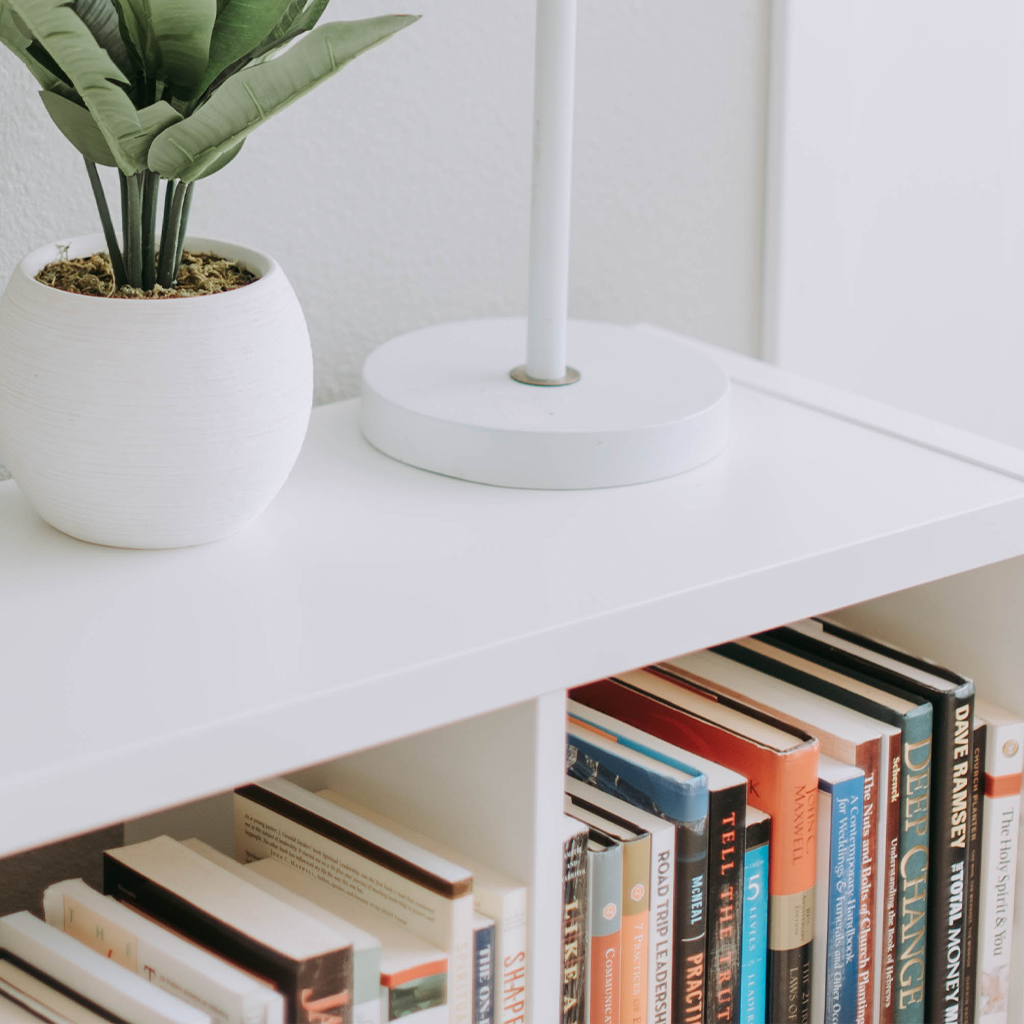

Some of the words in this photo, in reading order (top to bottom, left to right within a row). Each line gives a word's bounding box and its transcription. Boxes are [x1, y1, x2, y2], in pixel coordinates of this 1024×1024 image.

[953, 704, 970, 760] DAVE
[863, 771, 874, 801] The
[891, 756, 901, 803] Schenck
[905, 733, 932, 836] DEEP
[972, 747, 980, 792] CHURCH
[836, 797, 849, 815] for
[850, 795, 859, 804] A
[950, 762, 968, 848] RAMSEY
[970, 793, 978, 841] PLANTER
[793, 784, 806, 866] MAXWELL
[863, 802, 873, 837] Nuts
[1000, 807, 1014, 837] The
[721, 811, 736, 876] TELL
[835, 817, 848, 878] Weddings
[845, 807, 859, 896] Contemporary
[862, 839, 872, 865] and
[998, 839, 1012, 870] Holy
[657, 850, 670, 898] ROAD
[860, 865, 872, 901] Bolts
[887, 838, 898, 909] Understanding
[951, 860, 964, 873] THE
[690, 874, 704, 925] McNEAL
[747, 874, 760, 901] 5
[836, 880, 846, 893] &
[948, 870, 964, 926] TOTAL
[994, 873, 1011, 912] Spirit
[634, 922, 643, 930] 7
[656, 899, 669, 937] TRIP
[719, 886, 734, 940] THE
[749, 907, 757, 951] LEVELS
[835, 896, 845, 947] Funerals
[859, 906, 870, 915] of
[887, 909, 896, 926] the
[899, 845, 929, 1010] CHANGE
[994, 917, 1005, 930] &
[564, 899, 578, 984] LIKE
[845, 898, 856, 964] Handbook
[859, 918, 870, 968] Church
[887, 927, 895, 953] Book
[993, 931, 1006, 957] You
[479, 944, 491, 983] THE
[632, 934, 644, 995] PRACTICES
[834, 950, 843, 969] and
[886, 953, 894, 964] of
[945, 928, 961, 1002] MONEY
[685, 952, 704, 1024] PRACTI
[789, 967, 798, 1002] LAWS
[802, 992, 810, 1005] 21
[833, 972, 842, 1001] Other
[885, 965, 894, 1008] Hebrews
[563, 996, 577, 1014] A
[788, 1004, 798, 1021] OF
[944, 1004, 959, 1024] M
